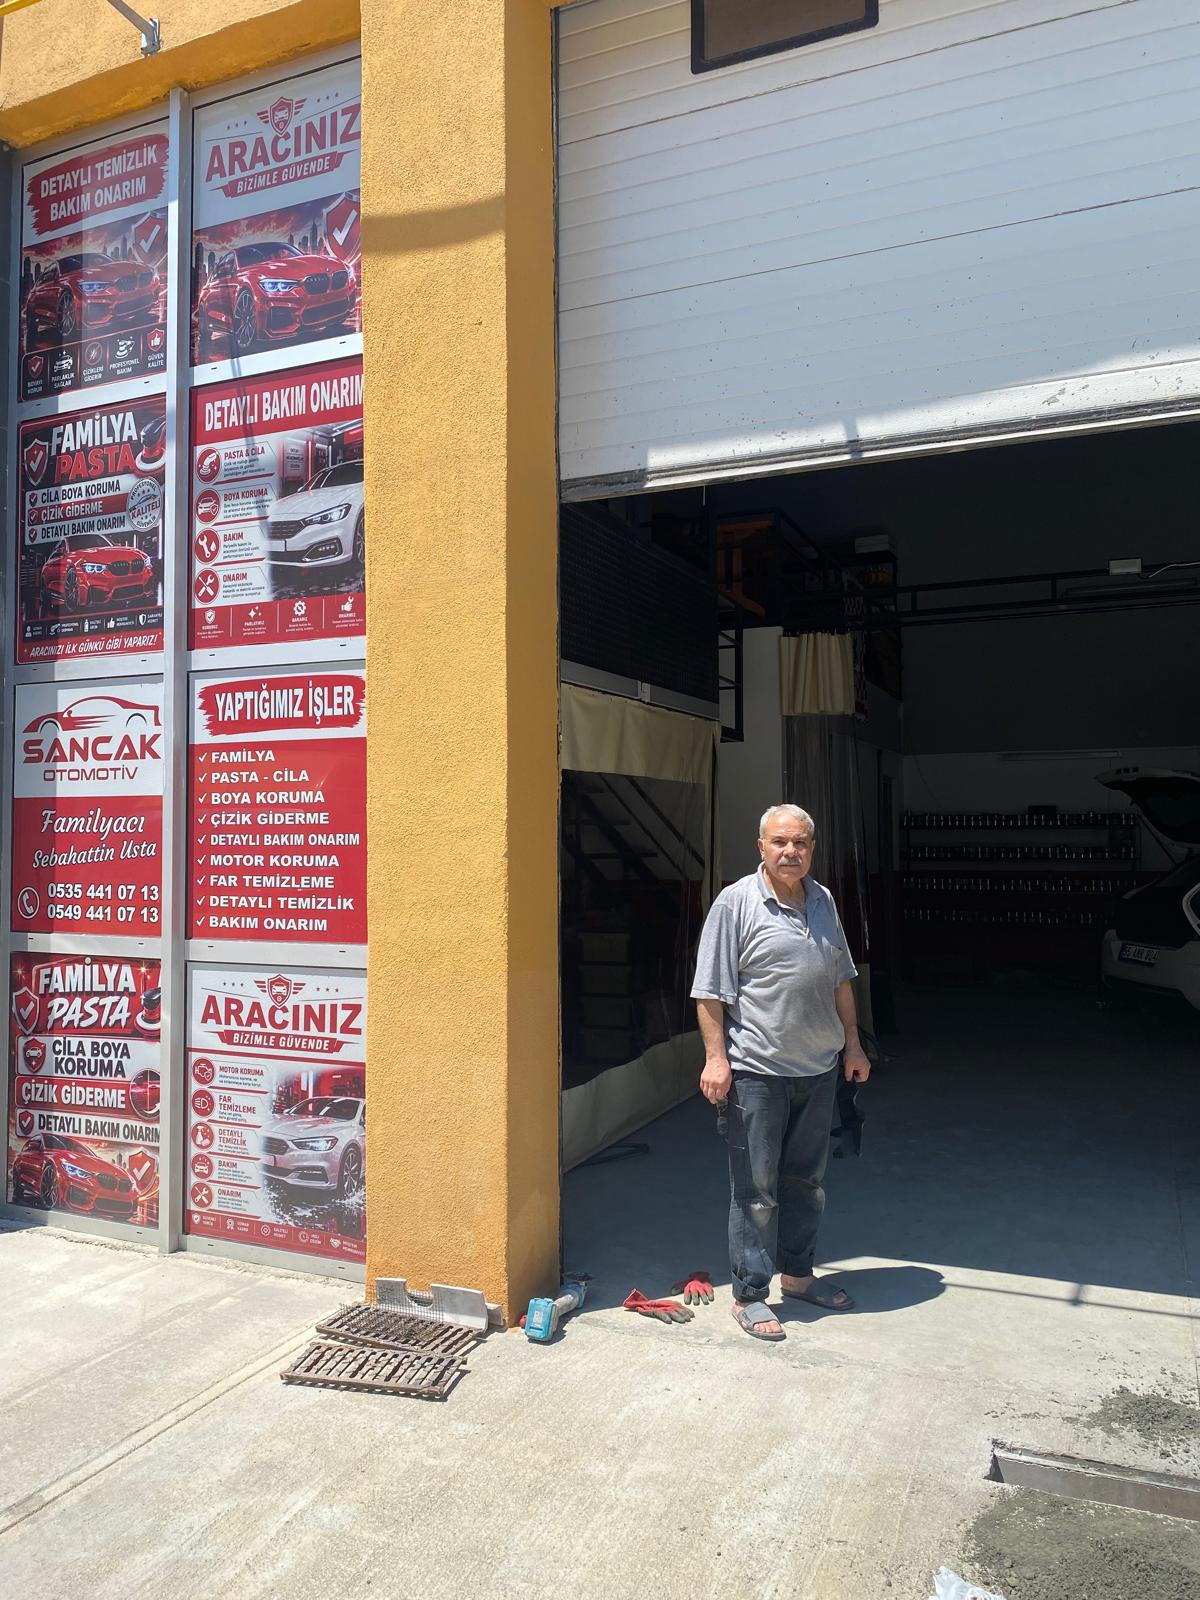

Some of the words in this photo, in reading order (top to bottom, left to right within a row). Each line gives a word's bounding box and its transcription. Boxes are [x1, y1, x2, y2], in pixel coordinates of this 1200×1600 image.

[206, 103, 361, 182] ARACINIZ
[41, 166, 91, 198] DETAYLI
[95, 143, 157, 181] TEMİZLİK
[237, 171, 278, 193] BİZİMLE
[282, 156, 330, 181] GÜVENDE
[50, 192, 91, 221] BAKIM
[95, 176, 146, 208] ONARIM
[109, 359, 140, 370] PROFESYONEL
[205, 394, 258, 432] DETAYLI
[262, 385, 306, 422] BAKIM
[310, 374, 363, 413] ONARIM
[51, 411, 138, 456] FAMİLYA
[224, 450, 244, 460] PASTA
[245, 448, 250, 457] &
[54, 443, 137, 484] PASTA
[41, 490, 60, 504] CİLA
[61, 486, 83, 501] BOYA
[86, 480, 120, 498] KORUMA
[224, 492, 240, 502] BOYA
[241, 488, 268, 500] KORUMA
[41, 504, 64, 522] ÇİZİK
[66, 501, 103, 516] GİDERME
[41, 525, 70, 539] DETAYLI
[72, 520, 95, 534] BAKIM
[96, 516, 126, 531] ONARIM
[224, 532, 244, 542] BAKIM
[222, 572, 248, 582] ONARIM
[30, 646, 65, 658] ARACINIZI
[66, 642, 76, 654] İLK
[78, 638, 104, 652] GÜNKÜ
[106, 636, 121, 650] GİBİ
[124, 634, 158, 649] YAPARIZ!
[215, 683, 304, 722] YAPTIĞIMIZ
[308, 680, 355, 724] İŞLER
[22, 734, 162, 764] SANCAK
[211, 749, 276, 763] FAMİLYA
[43, 764, 138, 782] OTOMOTİV
[211, 771, 259, 784] PASTA
[273, 768, 310, 782] CİLA
[211, 792, 251, 804] BOYA
[256, 790, 325, 804] KORUMA
[40, 808, 145, 840] Familyacı
[210, 811, 252, 828] ÇİZİK
[257, 810, 330, 825] GİDERME
[210, 834, 260, 846] DETAYLI
[264, 834, 304, 846] BAKIM
[308, 834, 360, 846] ONARIM
[32, 844, 114, 868] Sebahattin
[120, 840, 157, 860] Usta
[210, 854, 264, 867] MOTOR
[269, 855, 340, 867] KORUMA
[209, 875, 238, 887] FAR
[242, 874, 335, 888] TEMİZLEME
[48, 883, 82, 899] 0535
[86, 884, 112, 899] 441
[118, 885, 136, 900] 07
[140, 886, 159, 900] 13
[209, 896, 272, 909] DETAYLI
[277, 895, 354, 910] TEMİZLİK
[48, 904, 82, 919] 0549
[86, 905, 112, 921] 441
[117, 906, 136, 922] 07
[140, 908, 159, 922] 13
[208, 916, 258, 929] BAKIM
[263, 918, 328, 931] ONARIM
[38, 957, 136, 994] FAMİLYA
[46, 996, 131, 1031] PASTA
[200, 994, 362, 1036] ARACINIZ
[52, 1036, 86, 1058] CİLA
[90, 1042, 131, 1060] BOYA
[233, 1033, 276, 1047] BİZİMLE
[279, 1034, 330, 1051] GÜVENDE
[54, 1056, 126, 1078] KORUMA
[219, 1066, 238, 1074] MOTOR
[240, 1068, 264, 1076] KORUMA
[21, 1079, 58, 1106] ÇİZİK
[61, 1082, 126, 1109] GİDERME
[218, 1094, 232, 1103] FAR
[219, 1103, 257, 1114] TEMİZLEME
[38, 1114, 82, 1134] DETAYLI
[84, 1119, 120, 1138] BAKIM
[122, 1125, 160, 1144] ONARIM
[218, 1128, 243, 1138] DETAYLI
[218, 1136, 247, 1146] TEMİZLİK
[218, 1160, 238, 1168] BAKIM
[218, 1188, 242, 1198] ONARIM
